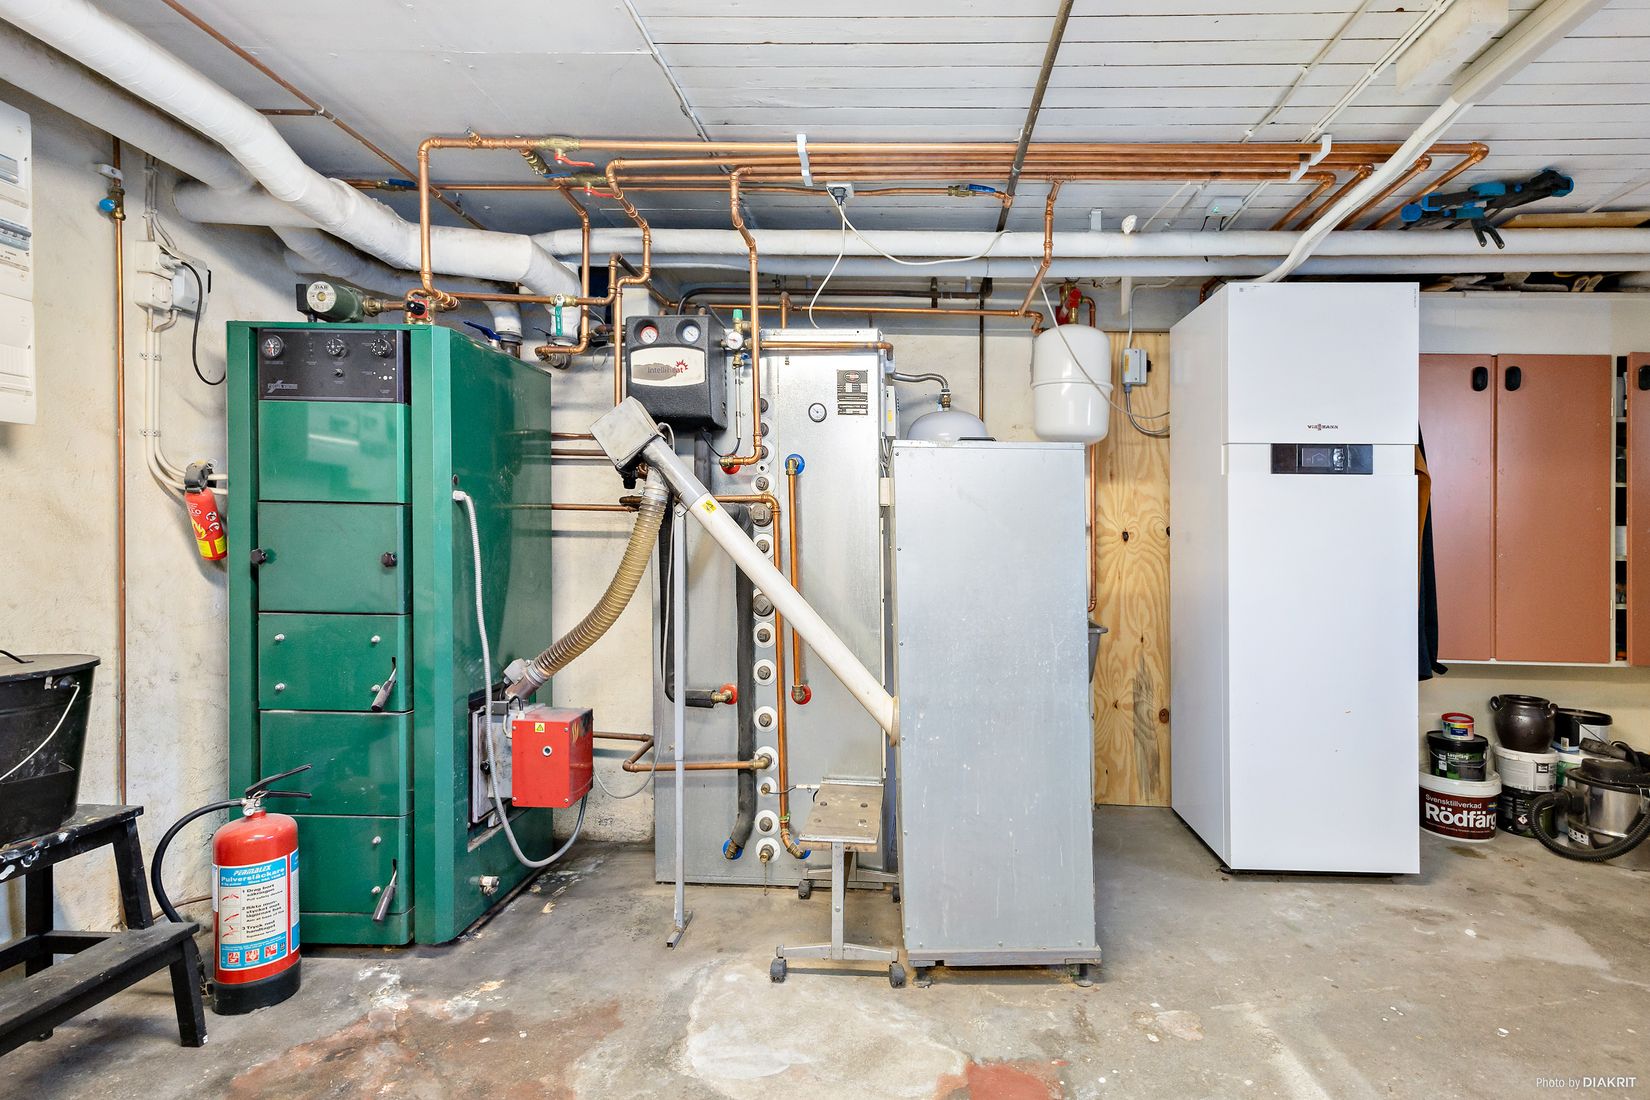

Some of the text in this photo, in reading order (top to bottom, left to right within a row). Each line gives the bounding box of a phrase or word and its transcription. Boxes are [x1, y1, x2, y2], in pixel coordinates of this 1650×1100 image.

[1425, 794, 1482, 809] Svensktillverkad
[1425, 802, 1497, 830] Rödfärg
[221, 867, 285, 883] Pulversläckare
